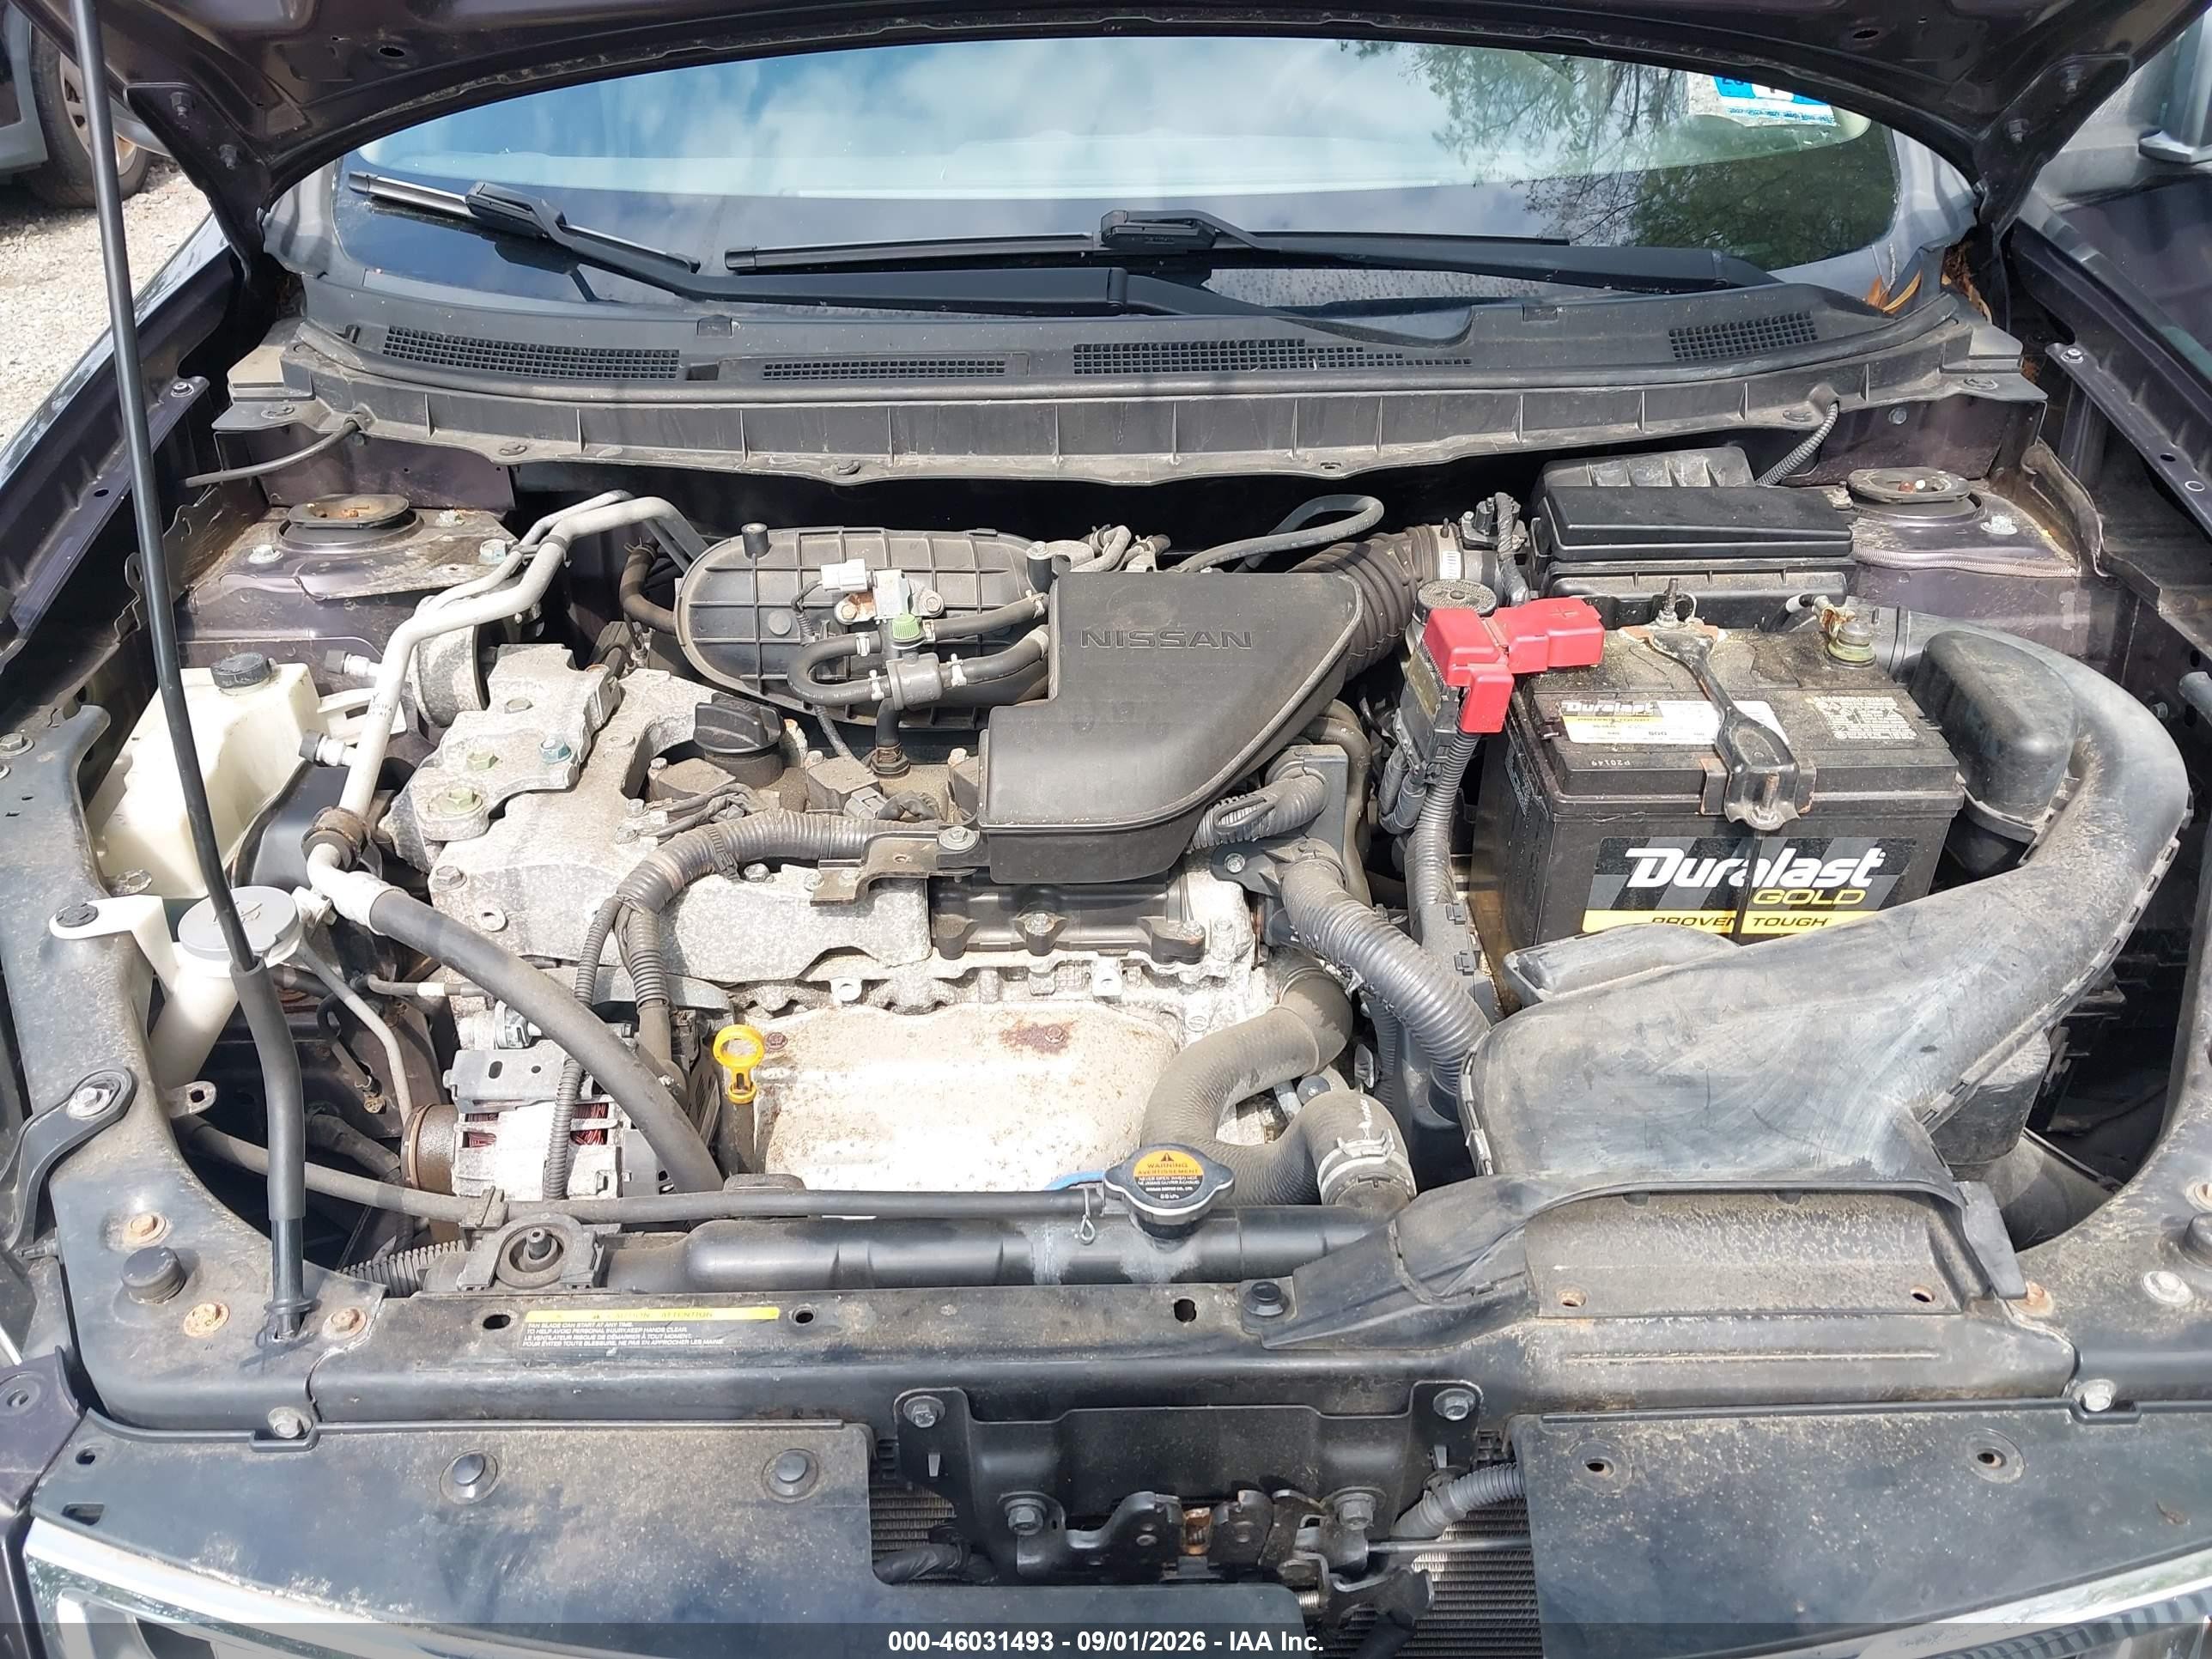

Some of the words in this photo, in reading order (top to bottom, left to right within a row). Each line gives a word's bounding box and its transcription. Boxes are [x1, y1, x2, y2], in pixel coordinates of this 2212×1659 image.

[1080, 629, 1253, 649] NISSAN
[1625, 848, 1885, 888] Duralast
[1753, 888, 1866, 905] GOLD
[1753, 917, 1828, 927] TOUGH
